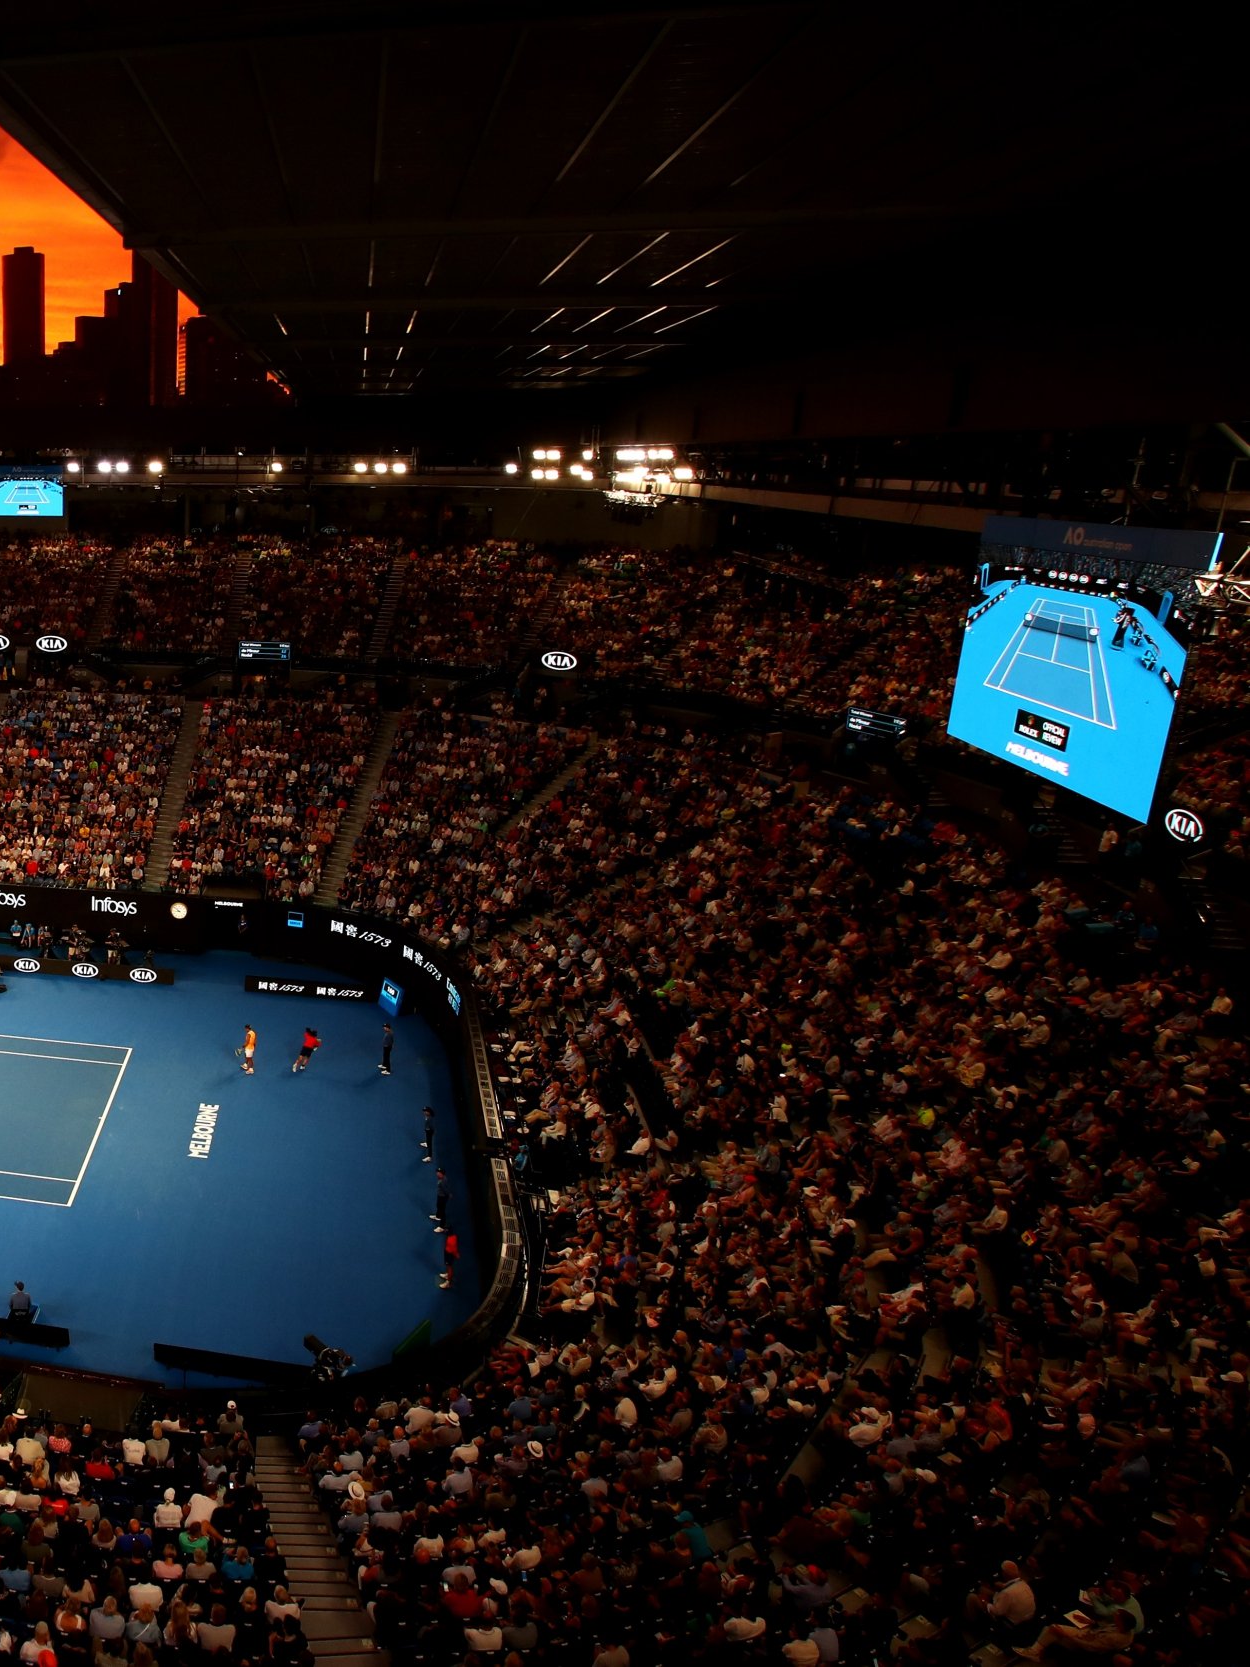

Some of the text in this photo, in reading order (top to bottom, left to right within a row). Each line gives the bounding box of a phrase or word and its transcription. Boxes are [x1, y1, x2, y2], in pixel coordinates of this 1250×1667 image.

[1063, 527, 1085, 545] AO
[41, 639, 62, 649] KIA
[547, 654, 571, 667] KIA
[1018, 724, 1040, 738] ROLEX
[1042, 721, 1066, 737] OFFICIAL
[1041, 731, 1064, 746] REVIEW
[1005, 741, 1070, 777] MELBOURNE
[1169, 813, 1195, 838] KIA
[91, 896, 137, 915] Infosys
[358, 930, 392, 948] 1573
[18, 961, 37, 970] KIA
[76, 966, 95, 975] KIA
[134, 971, 153, 980] KIA
[279, 984, 305, 992] 1573
[337, 989, 363, 998] 1573
[187, 1103, 219, 1158] MELBOURNE
